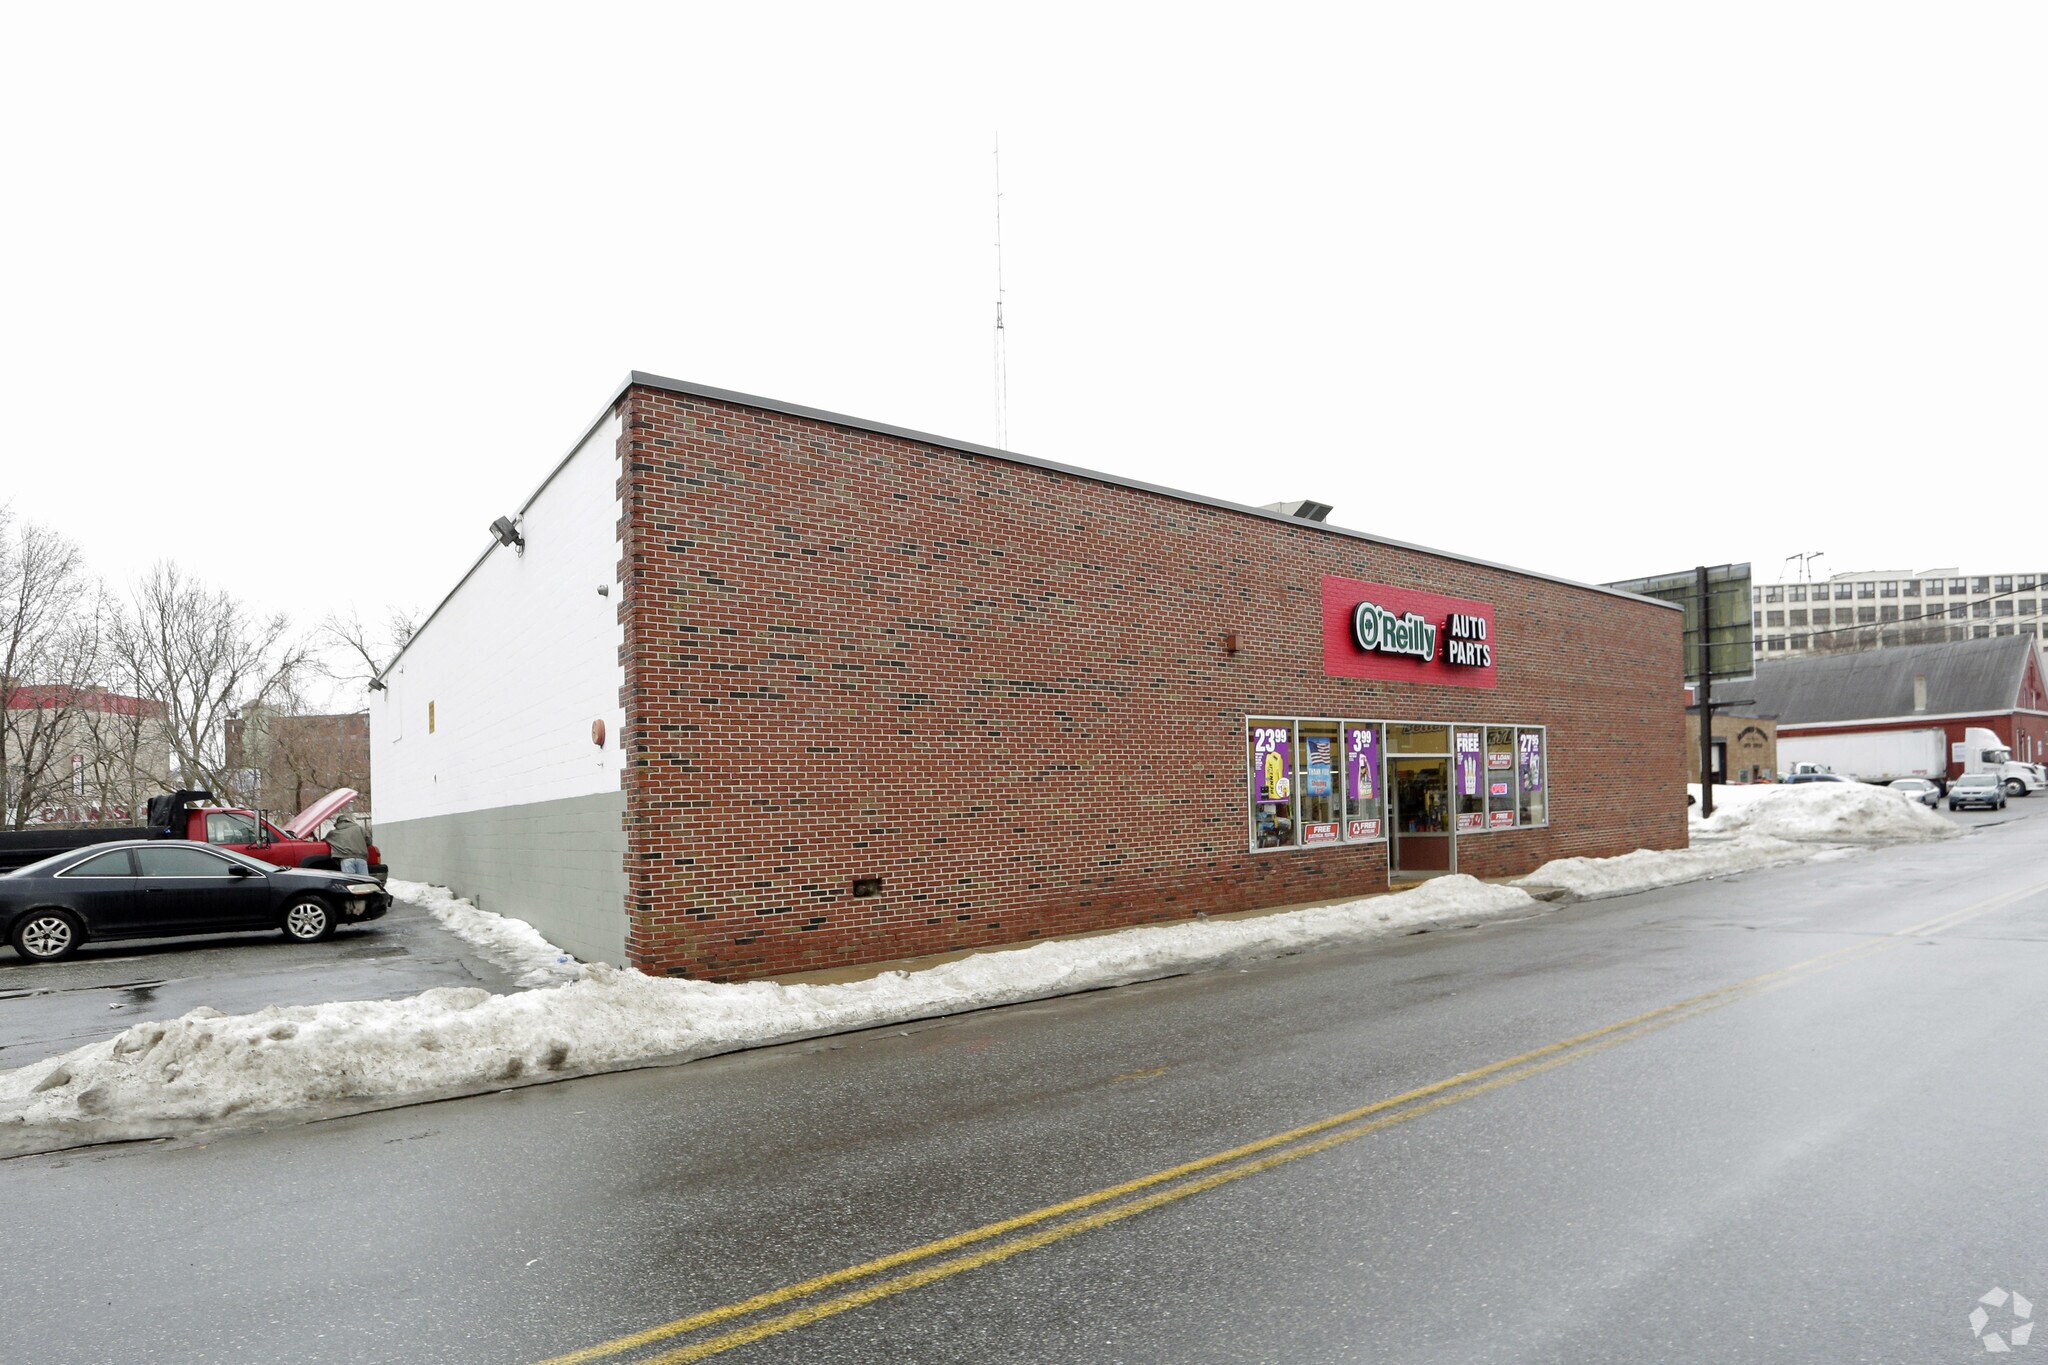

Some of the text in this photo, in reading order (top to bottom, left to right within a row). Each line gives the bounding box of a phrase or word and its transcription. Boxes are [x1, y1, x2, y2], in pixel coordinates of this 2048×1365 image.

[1359, 605, 1435, 658] O'Reilly
[1452, 613, 1487, 641] AUTO
[1449, 640, 1492, 667] PARTS
[1457, 738, 1479, 752] FREE
[1313, 825, 1331, 834] FREE
[1361, 821, 1377, 830] FREE
